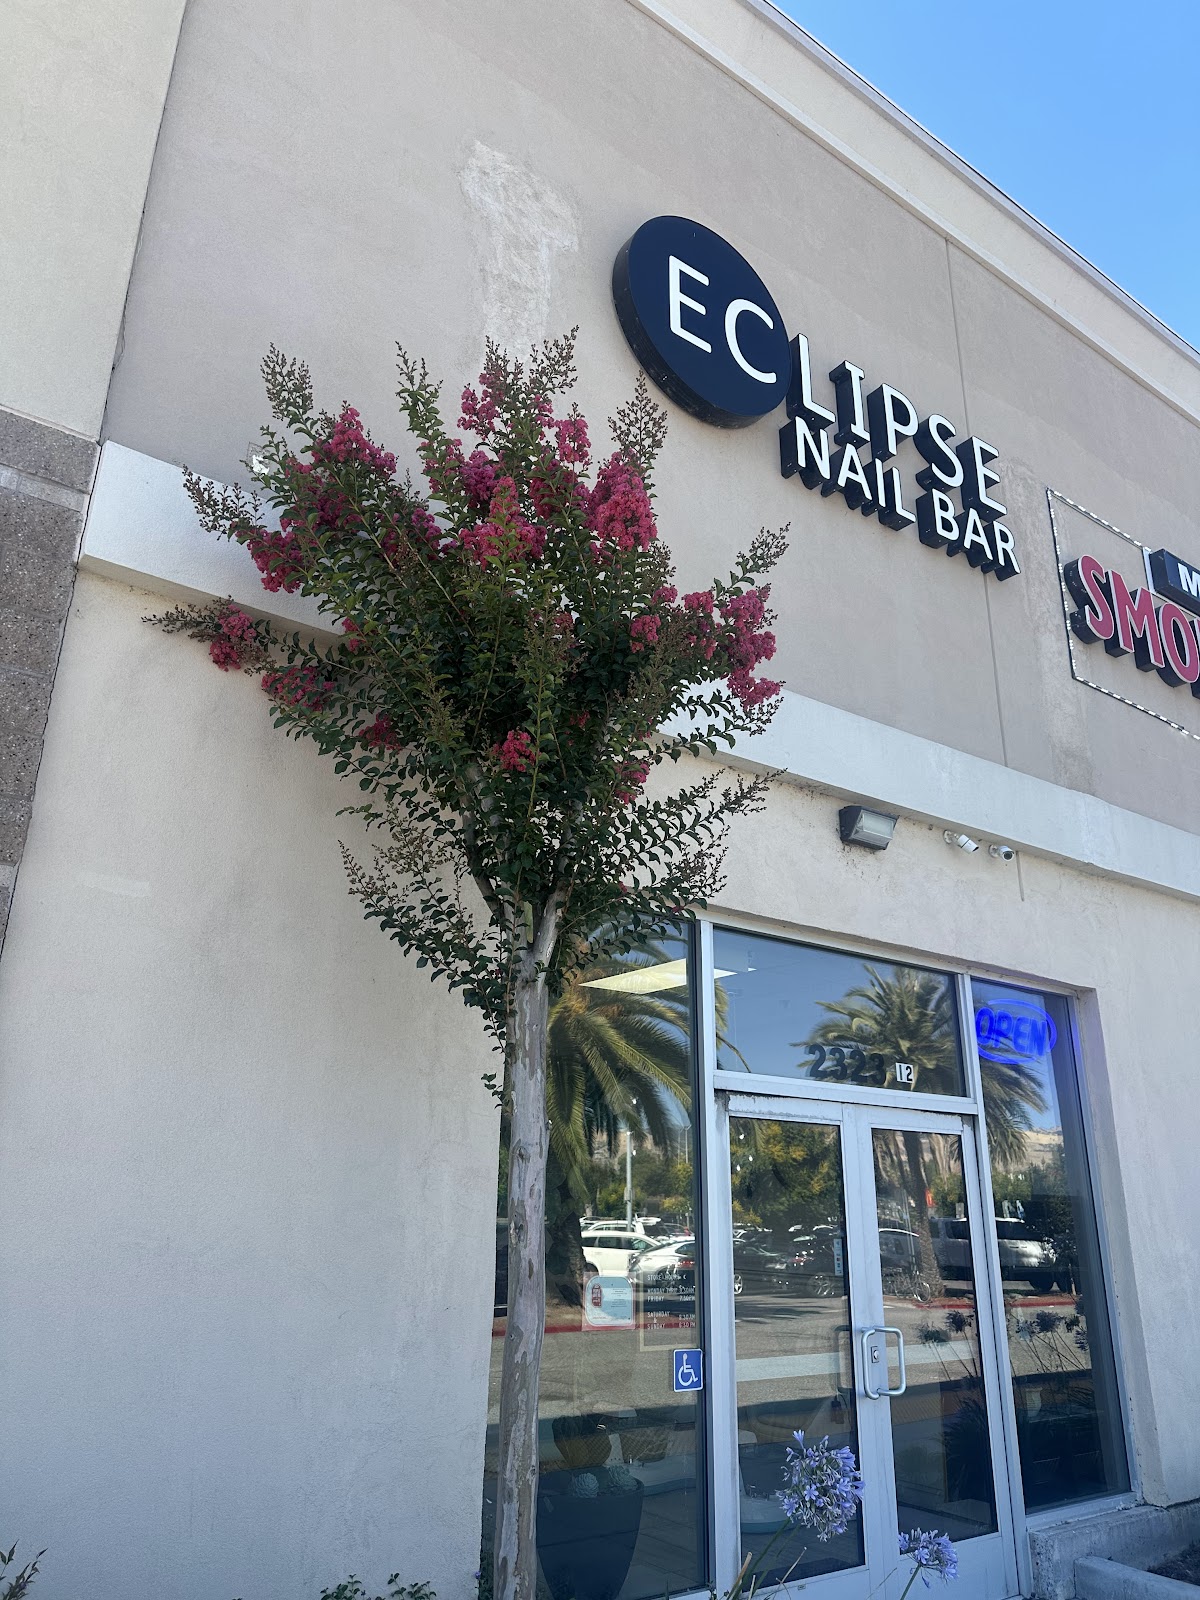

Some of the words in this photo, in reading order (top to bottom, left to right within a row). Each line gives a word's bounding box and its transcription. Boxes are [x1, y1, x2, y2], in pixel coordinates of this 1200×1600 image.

[669, 254, 1007, 515] ECLIPSE
[795, 416, 916, 523] NAIL
[931, 488, 1021, 574] BAR
[1077, 554, 1200, 684] SMO
[808, 1043, 887, 1085] 2323
[899, 1064, 913, 1082] 12
[975, 1006, 1047, 1057] OPEN
[647, 1311, 671, 1319] SATURDAY
